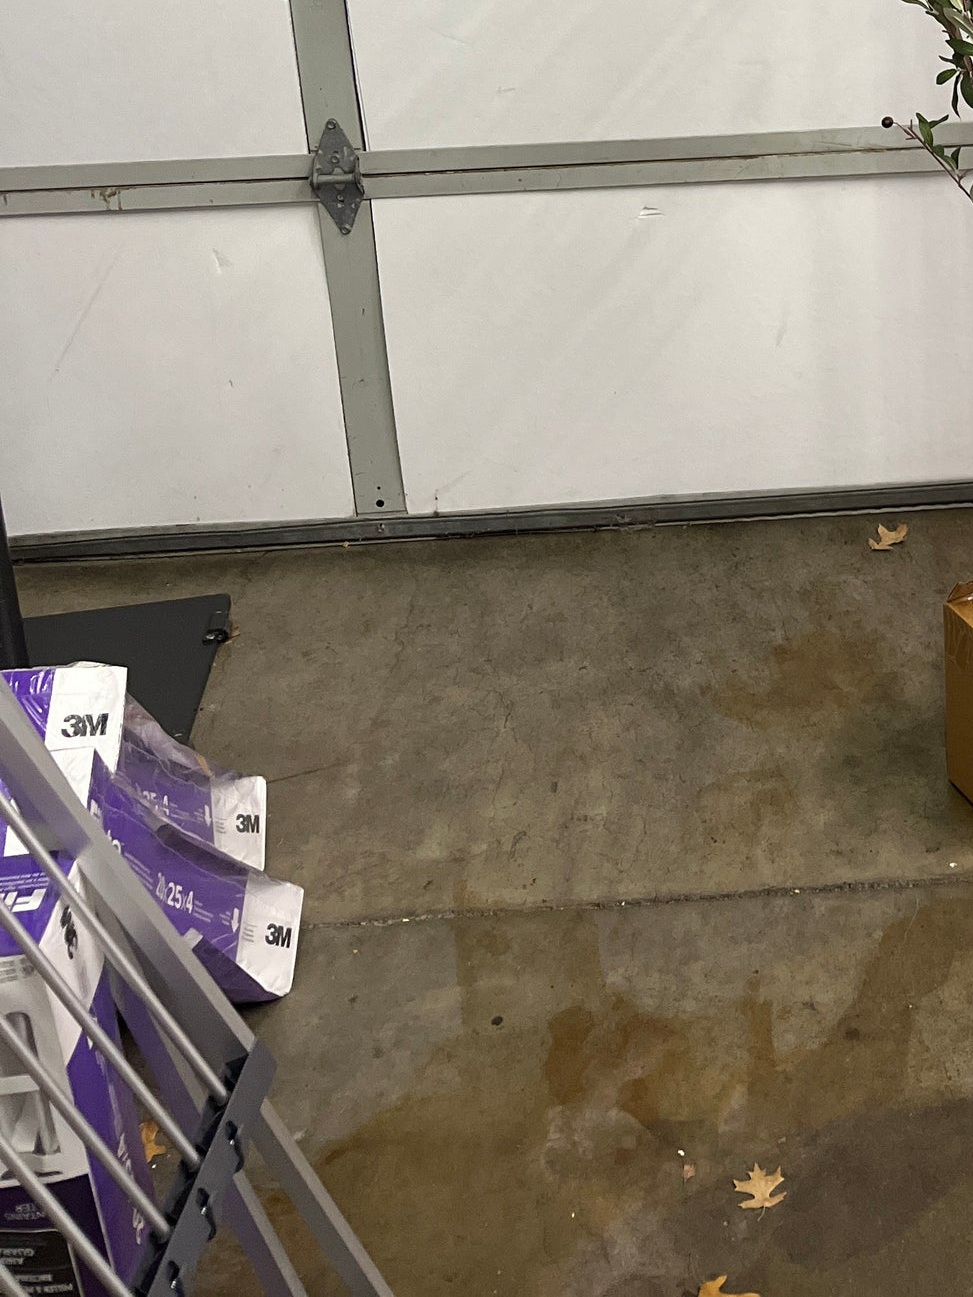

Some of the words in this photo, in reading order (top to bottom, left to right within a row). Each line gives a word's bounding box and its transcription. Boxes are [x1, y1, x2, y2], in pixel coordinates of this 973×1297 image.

[61, 713, 109, 738] 3M
[236, 814, 260, 834] 3M
[265, 923, 292, 949] 3M
